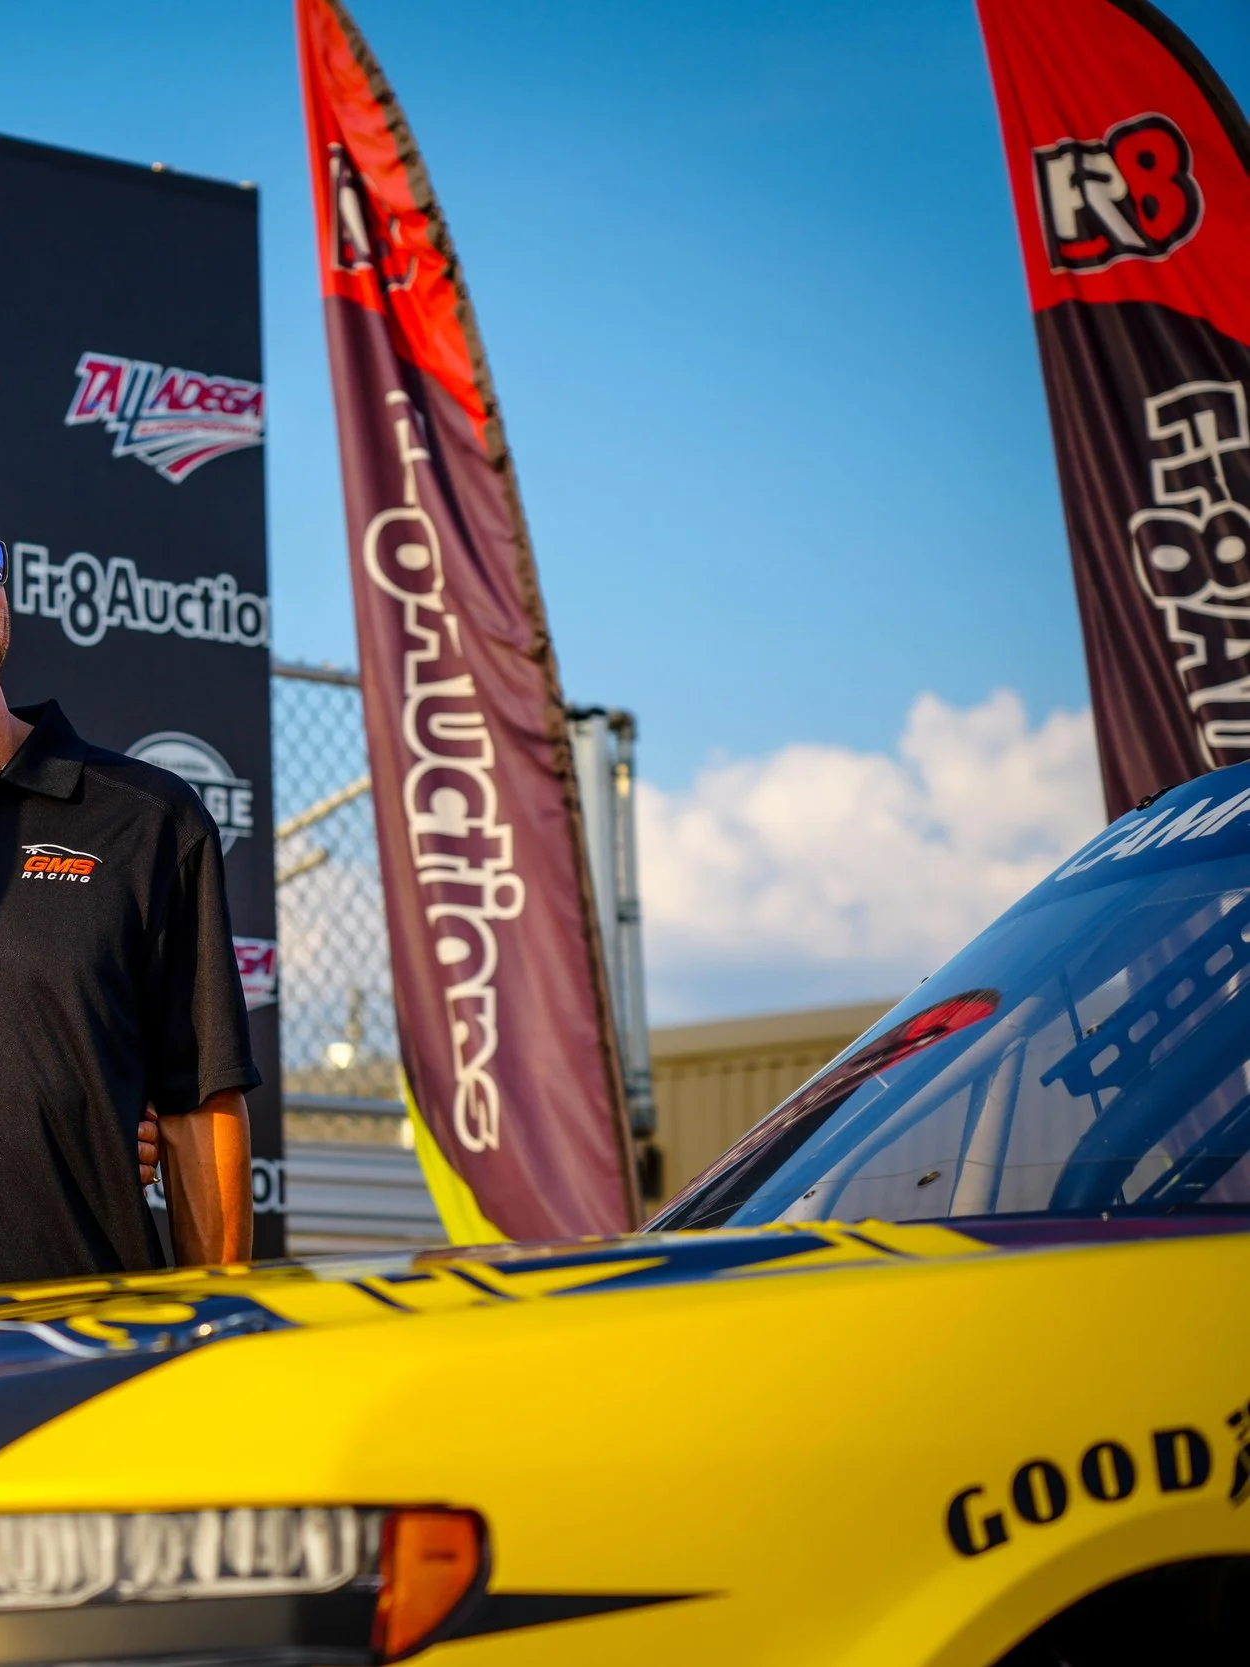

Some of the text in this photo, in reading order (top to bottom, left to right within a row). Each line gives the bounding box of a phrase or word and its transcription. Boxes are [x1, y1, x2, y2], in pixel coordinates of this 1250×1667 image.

[13, 542, 268, 647] Fr8Auctio
[21, 871, 91, 883] RACING
[23, 855, 95, 875] GMS
[946, 1426, 1212, 1558] GOOD
